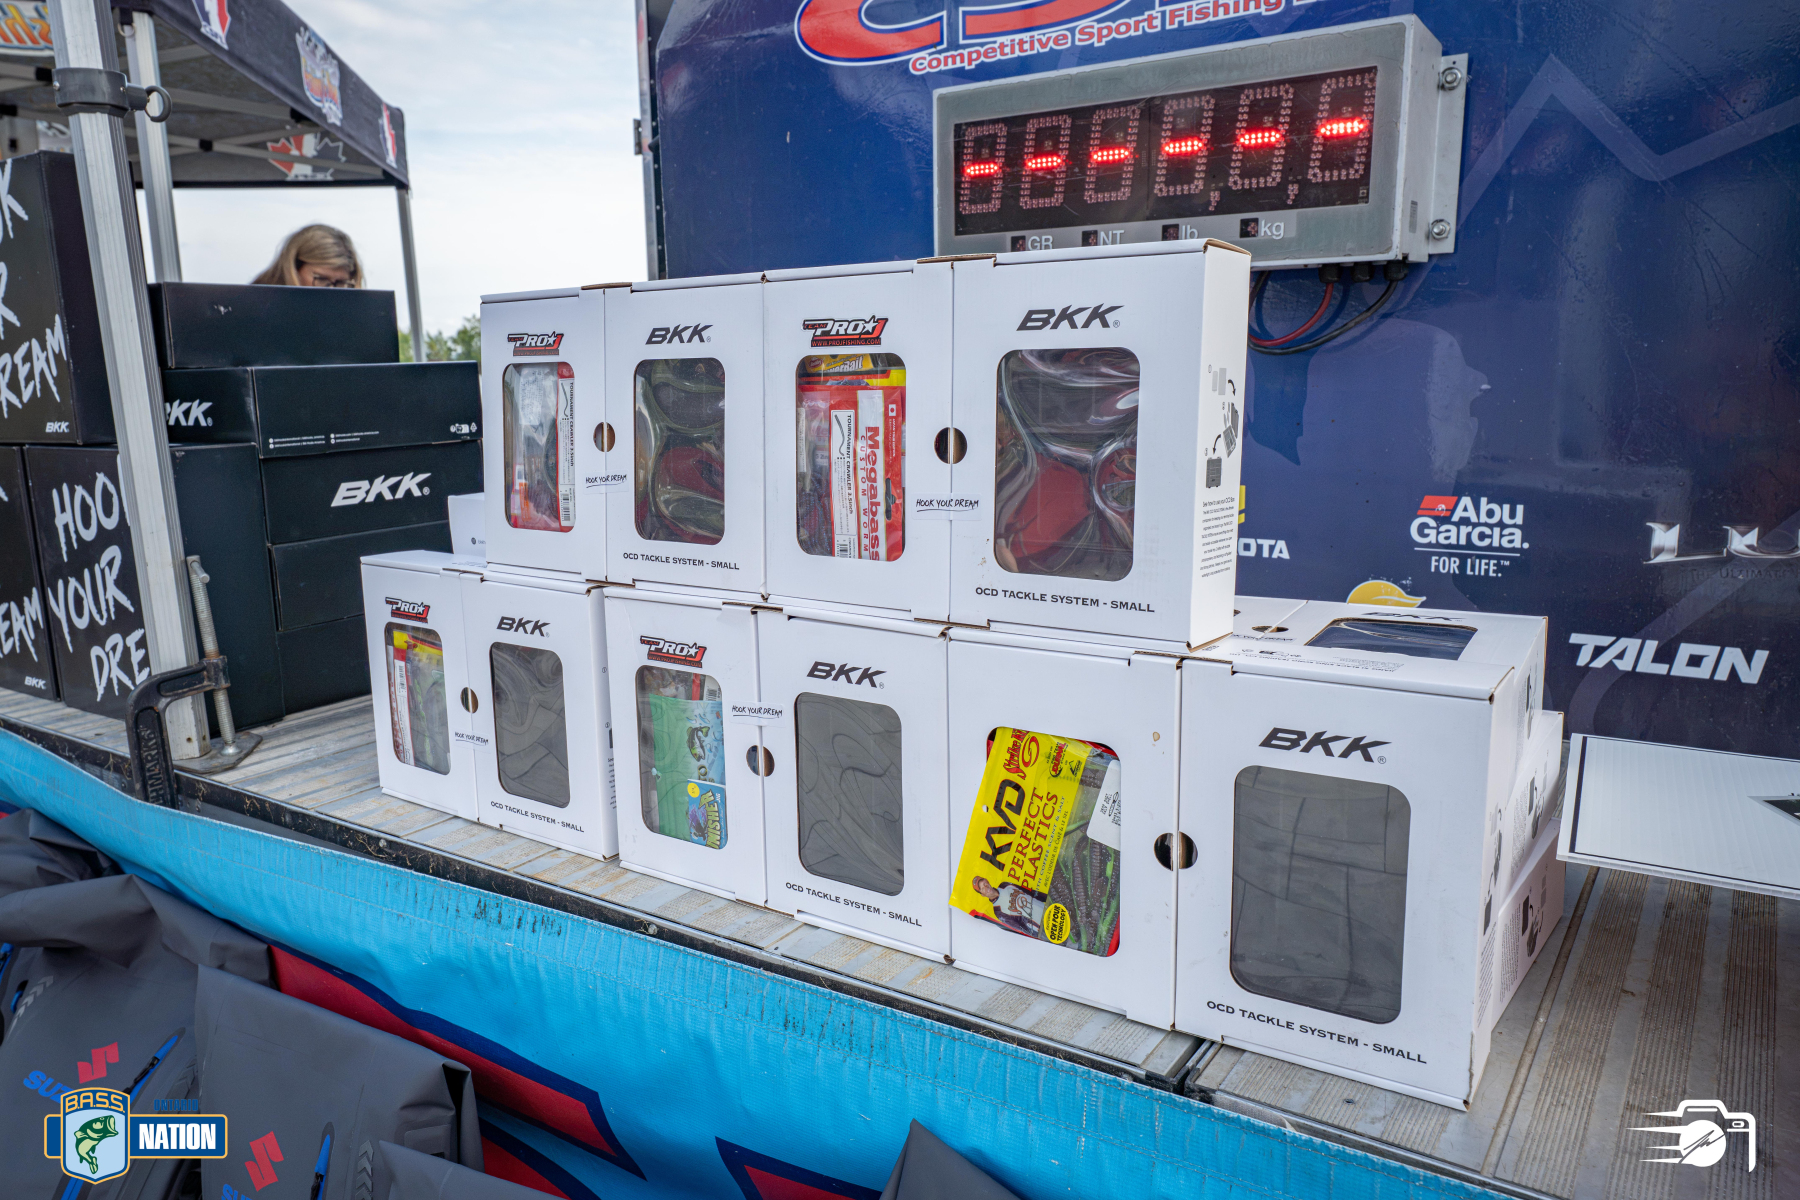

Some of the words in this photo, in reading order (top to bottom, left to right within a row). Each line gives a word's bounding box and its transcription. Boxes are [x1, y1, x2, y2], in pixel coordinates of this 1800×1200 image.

[910, 32, 1070, 73] Competitive
[1077, 14, 1159, 45] Sport
[1168, 0, 1283, 26] Fishing
[1028, 235, 1054, 250] GR
[1100, 230, 1124, 245] NT
[1181, 225, 1199, 240] lb
[1260, 219, 1285, 240] kg
[1016, 303, 1125, 331] BKK
[645, 323, 714, 345] BKK
[45, 421, 70, 433] BKK
[331, 472, 432, 508] BKK
[866, 426, 881, 561] Megabass
[916, 498, 935, 508] HOOK
[954, 498, 979, 510] DREAM
[52, 453, 131, 563] HOO
[1451, 496, 1524, 525] Abu
[623, 552, 638, 561] OCD
[640, 554, 670, 564] TACKLE
[672, 556, 704, 568] SYSTEM
[711, 560, 740, 571] SMALL
[1237, 538, 1291, 560] OTA
[1430, 556, 1460, 574] FOR
[48, 545, 134, 653] YOUR
[975, 586, 999, 597] OCD
[1002, 590, 1048, 602] TACKLE
[1050, 594, 1100, 608] SYSTEM
[1110, 600, 1155, 613] SMALL
[496, 616, 551, 638] BKK
[90, 628, 150, 702] DRE
[1569, 633, 1770, 684] TALON
[24, 676, 47, 690] BKK
[806, 660, 887, 689] BKK
[732, 705, 747, 714] HOOK
[763, 708, 783, 718] DREAM
[1050, 742, 1066, 775] JOURNAL
[1258, 727, 1392, 764] BKK
[1003, 741, 1027, 781] Strike
[490, 800, 504, 810] OCD
[504, 804, 529, 817] TACKLE
[530, 812, 556, 825] SYSTEM
[561, 820, 585, 833] SMALL
[980, 778, 1026, 872] KVD
[1008, 787, 1044, 882] PERFECT
[1021, 792, 1058, 892] PLASTICS
[1040, 849, 1050, 876] COFFEE
[1048, 822, 1058, 848] SCENT
[1057, 796, 1066, 814] SALT
[786, 882, 804, 893] OCD
[806, 888, 841, 904] TACKLE
[844, 898, 881, 915] SYSTEM
[888, 911, 923, 927] SMALL
[1053, 905, 1061, 923] POUR
[1050, 923, 1058, 941] OPEN
[1057, 908, 1066, 942] TECHNOLOGY
[1206, 1000, 1235, 1015] OCD
[1238, 1006, 1295, 1031] TACKLE
[1299, 1023, 1359, 1047] SYSTEM
[1372, 1042, 1427, 1065] SMALL
